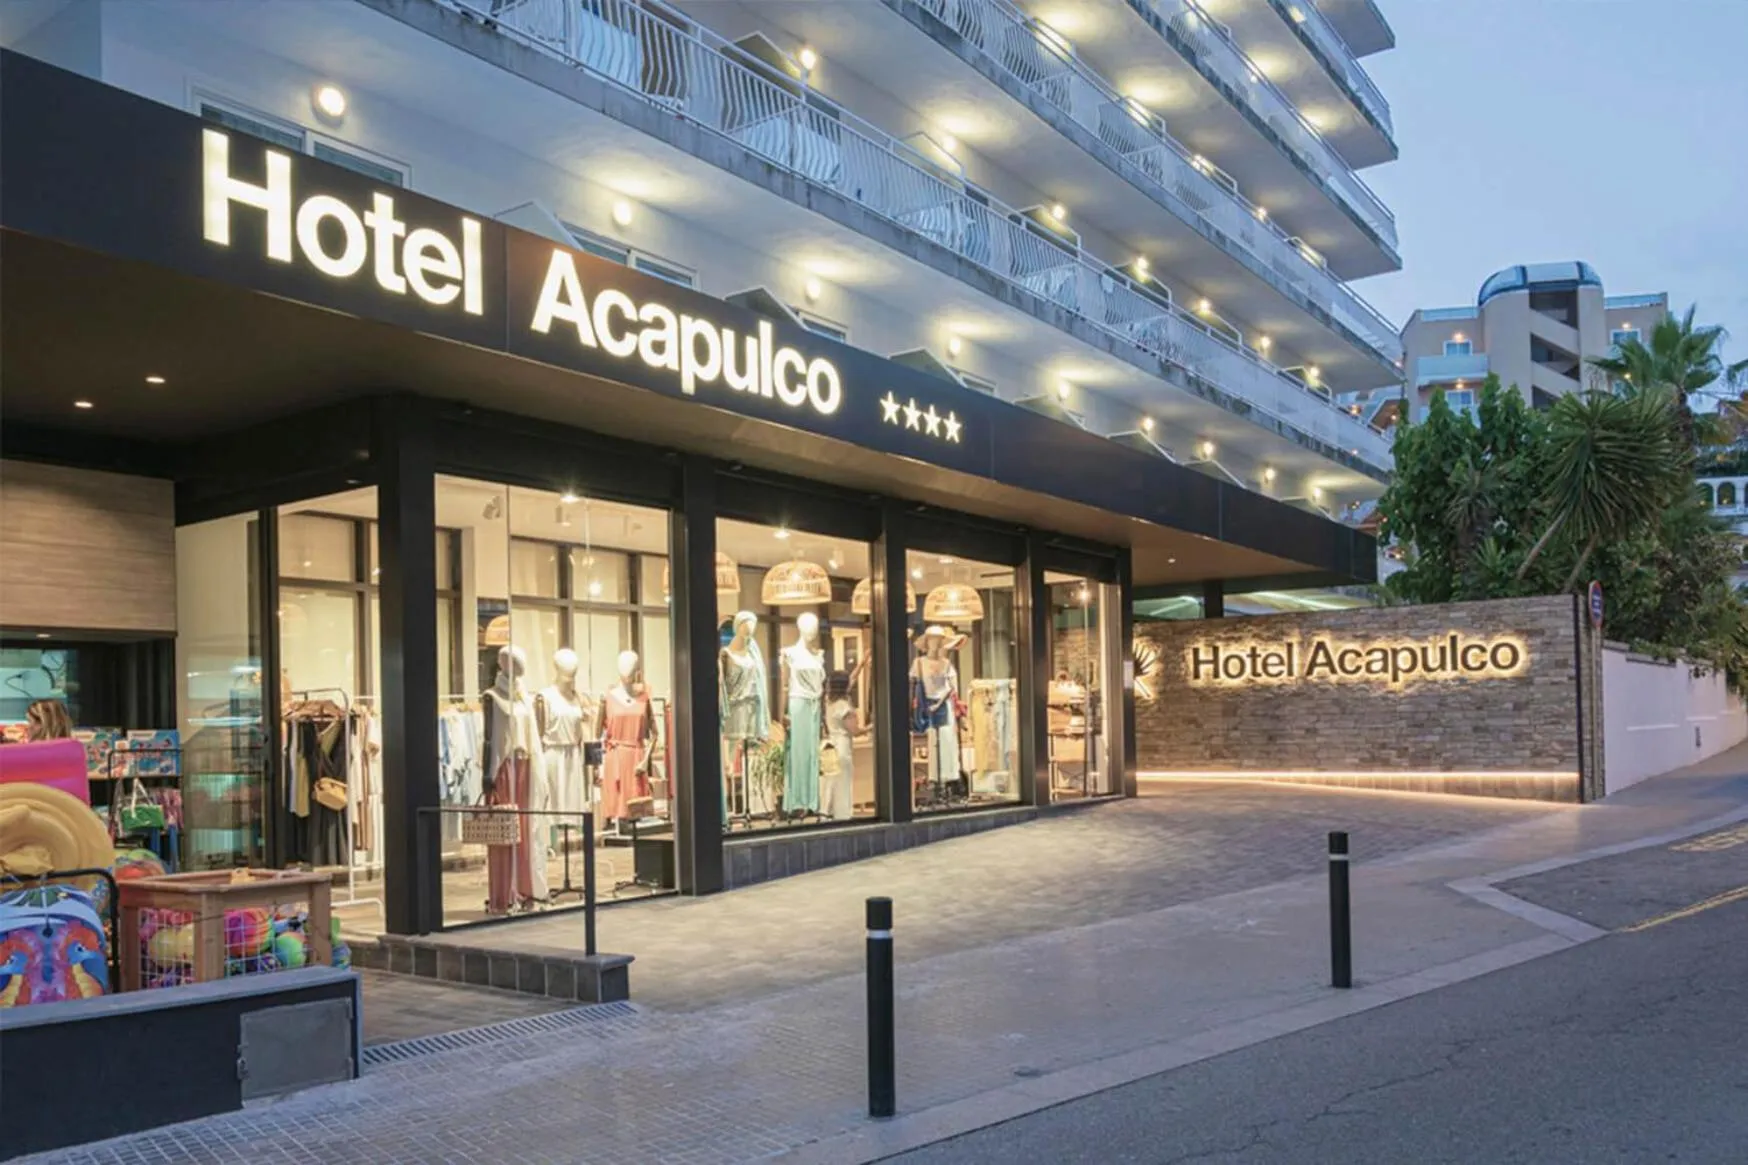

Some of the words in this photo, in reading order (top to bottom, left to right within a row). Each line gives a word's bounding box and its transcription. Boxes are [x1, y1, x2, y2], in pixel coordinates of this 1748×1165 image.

[203, 129, 483, 315] Hotel
[530, 249, 841, 414] Acapulco
[1192, 642, 1294, 680] Hotel
[1306, 635, 1520, 682] Acapulco
